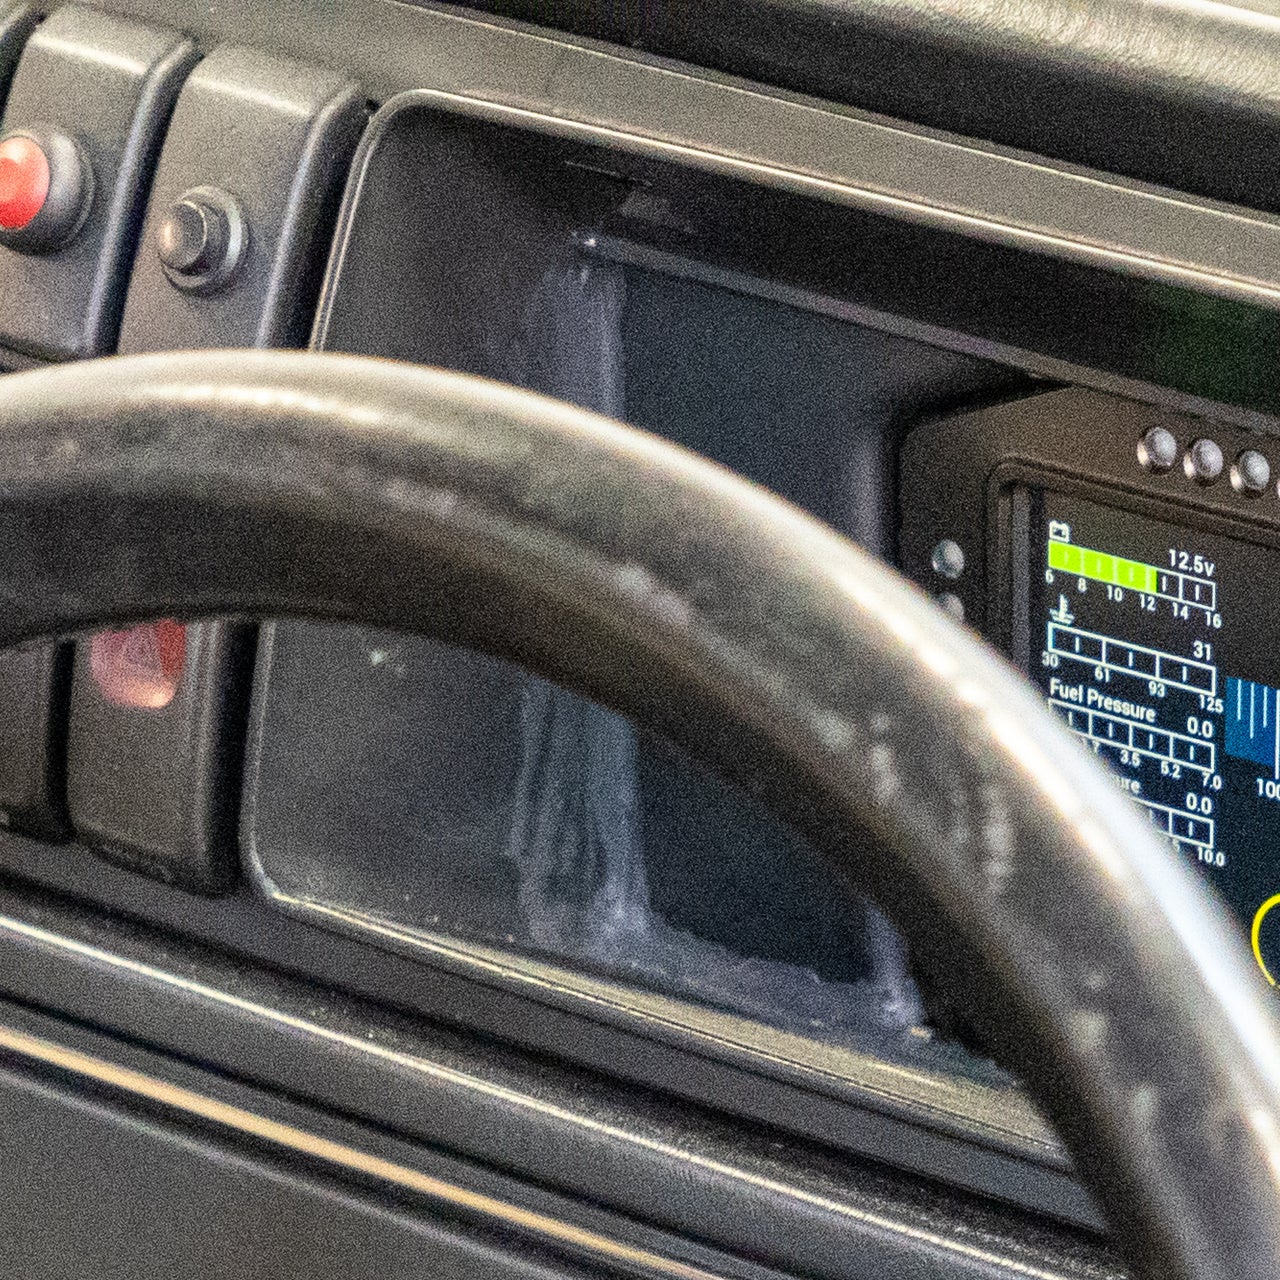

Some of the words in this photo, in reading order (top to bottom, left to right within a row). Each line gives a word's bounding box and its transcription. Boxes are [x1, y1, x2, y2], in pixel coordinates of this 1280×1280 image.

[1045, 570, 1054, 583] 6
[1078, 578, 1087, 592] 8
[1107, 585, 1123, 602] 10
[1139, 593, 1157, 611] 12
[1172, 602, 1190, 620] 14
[1205, 611, 1222, 629] 16
[1193, 640, 1212, 660] 31
[1042, 651, 1059, 668] 30
[1095, 666, 1110, 683] 61
[1148, 681, 1166, 698] 93
[1199, 695, 1224, 713] 125
[1049, 677, 1084, 702] Fuel
[1087, 687, 1157, 723] Pressure
[1187, 716, 1213, 739] 0.0
[1120, 749, 1141, 767] 3.5
[1160, 760, 1181, 779] 5.2
[1202, 771, 1222, 790] 7.0
[1186, 792, 1213, 814] 0.0
[1197, 847, 1226, 867] 10.0
